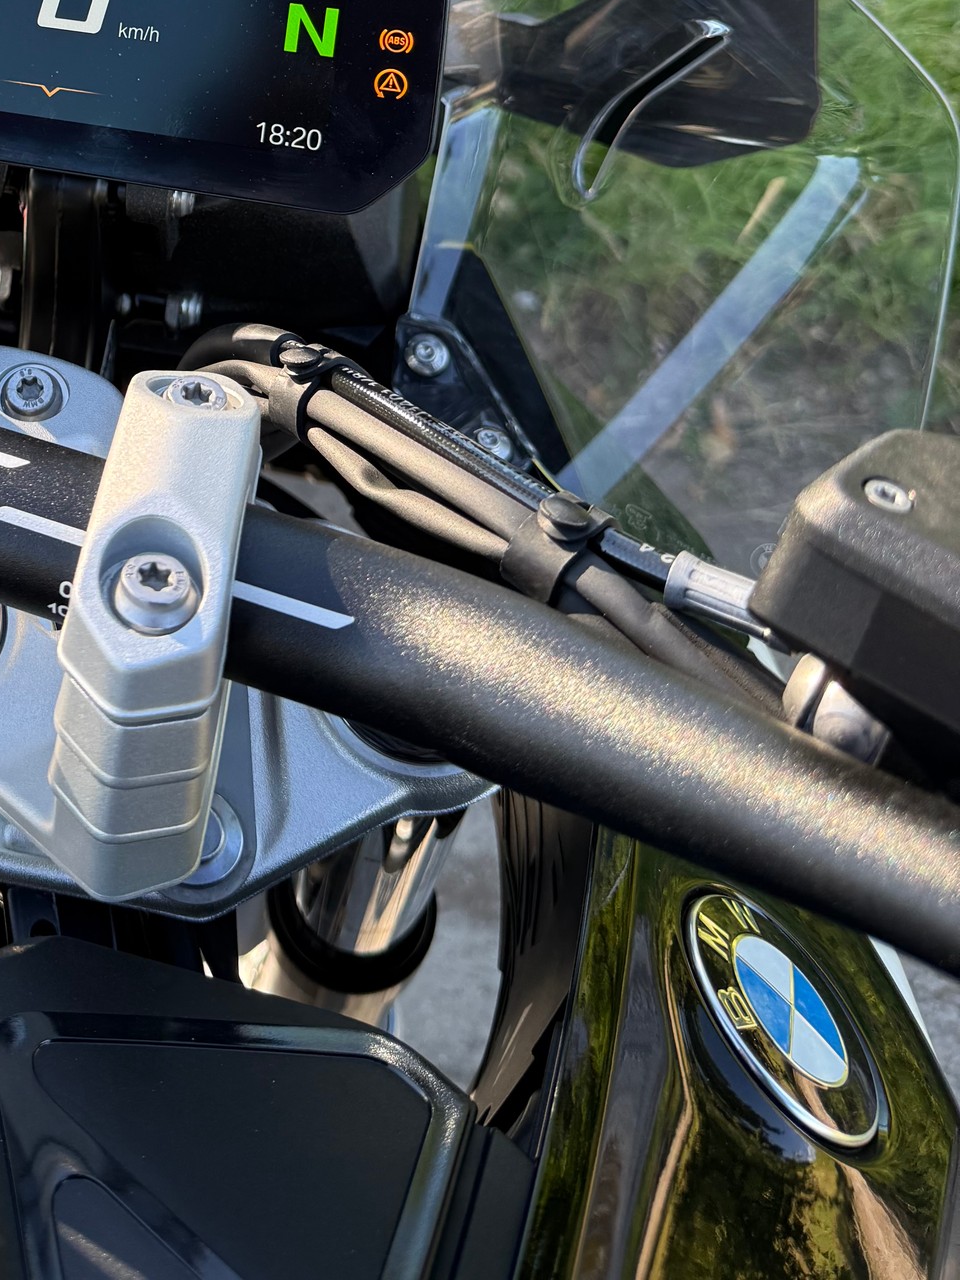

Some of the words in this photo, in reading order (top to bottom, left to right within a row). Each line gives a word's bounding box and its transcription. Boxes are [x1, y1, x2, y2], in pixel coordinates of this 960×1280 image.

[118, 22, 160, 43] km/h
[283, 2, 340, 58] N
[388, 35, 406, 46] ABS
[256, 121, 322, 151] 18:20
[696, 897, 762, 1031] BMW
